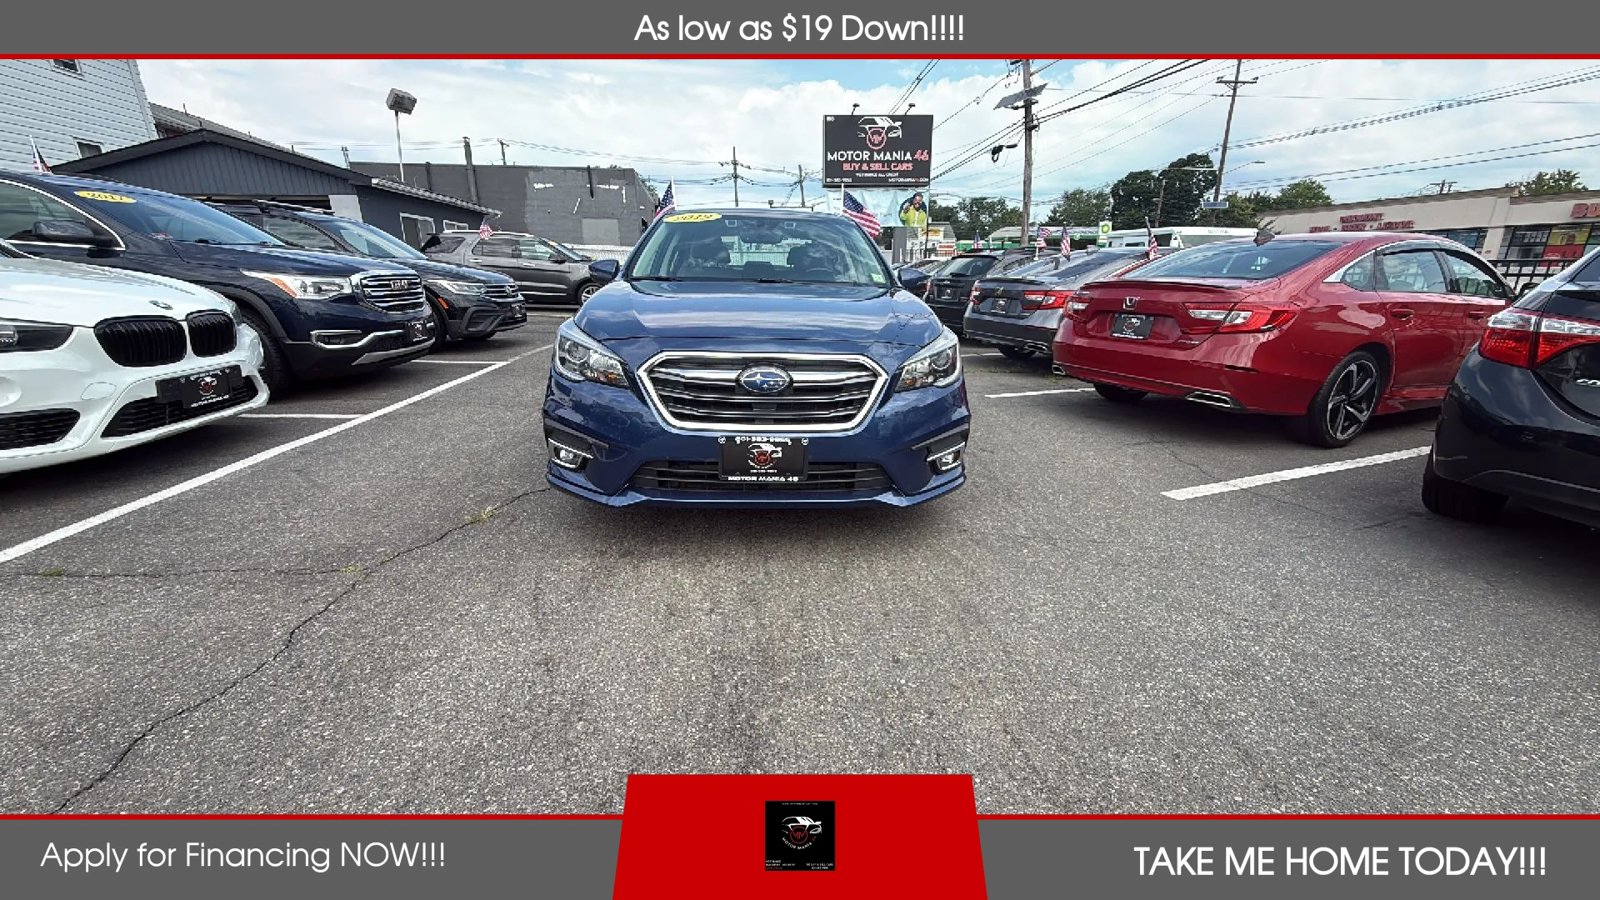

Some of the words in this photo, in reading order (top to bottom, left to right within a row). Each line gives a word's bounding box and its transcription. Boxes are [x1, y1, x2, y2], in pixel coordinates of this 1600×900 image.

[827, 150, 871, 161] MOTOR
[873, 150, 913, 161] MANIA
[914, 149, 930, 161] 46
[842, 162, 861, 171] BUY
[861, 162, 869, 171] &
[869, 162, 890, 171] SELL
[890, 162, 914, 171] CARS
